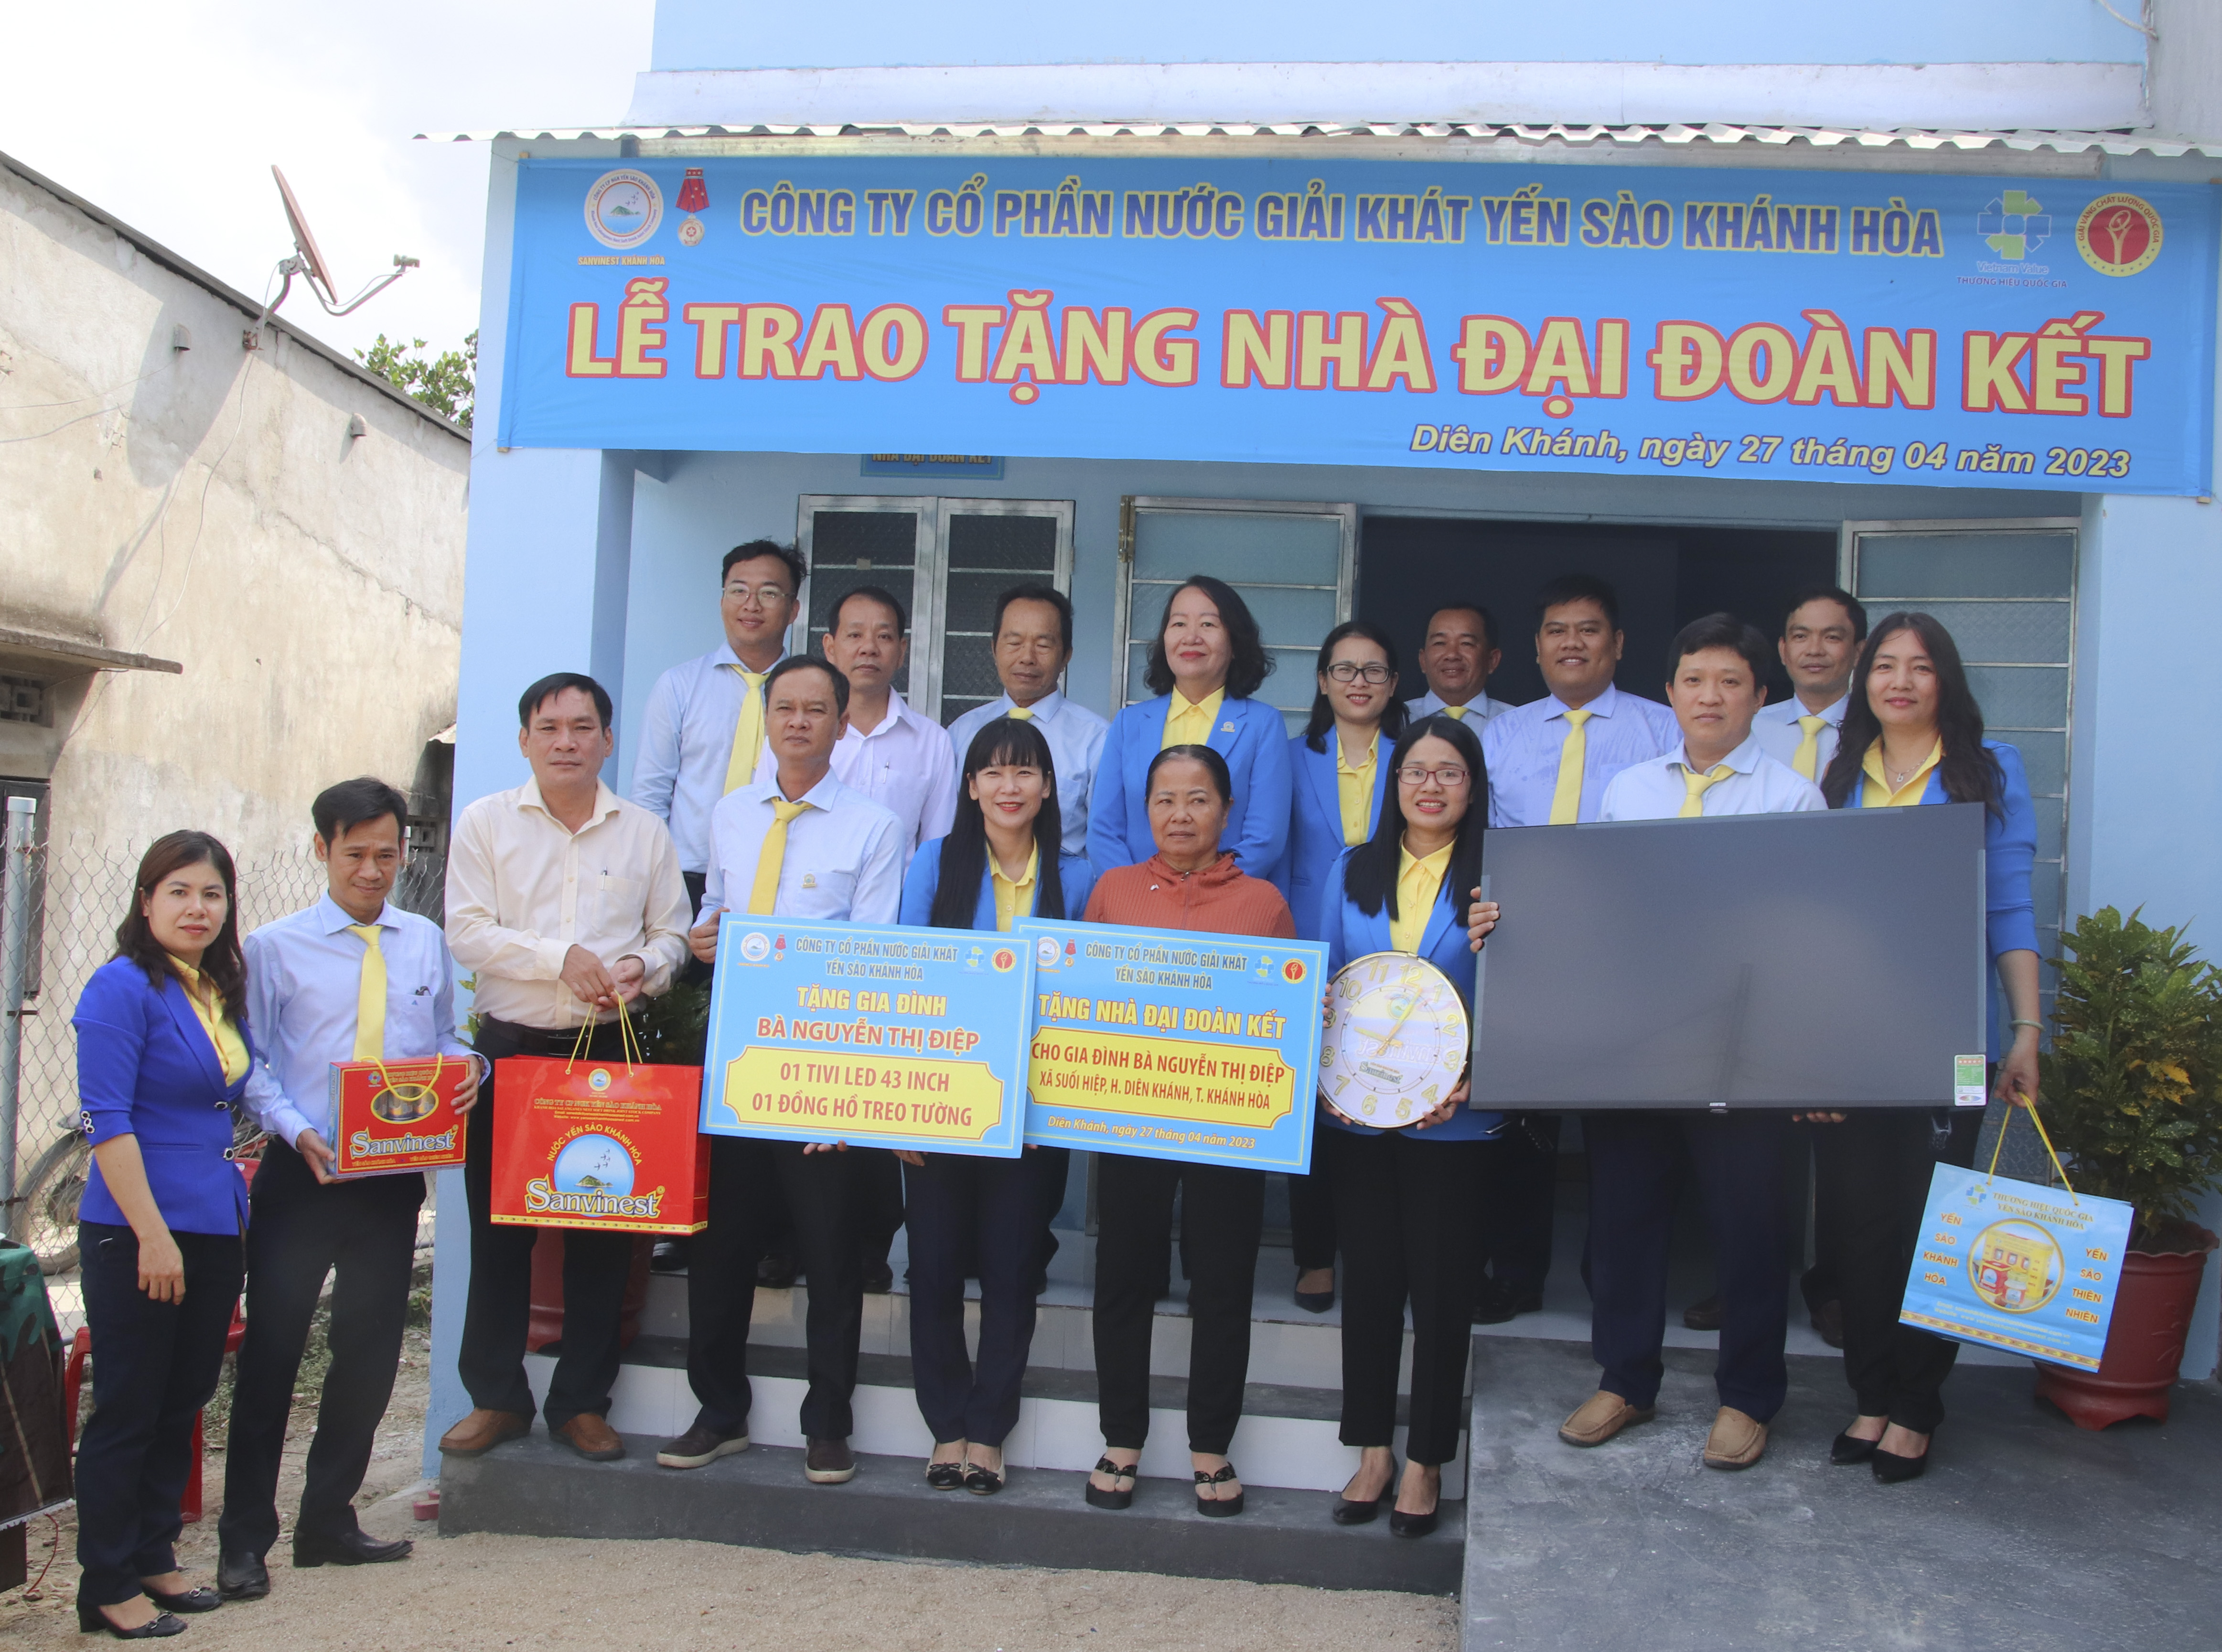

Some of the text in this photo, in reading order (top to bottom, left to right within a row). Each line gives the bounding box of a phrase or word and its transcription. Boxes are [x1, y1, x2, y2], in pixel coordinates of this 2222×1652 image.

[741, 181, 855, 236] CÔNG
[866, 189, 916, 236] TY
[925, 173, 988, 236] CỔ
[994, 176, 1114, 238] PHẦN
[1123, 182, 1244, 239] NƯỚC
[1256, 179, 1346, 240] GIẢI
[1356, 185, 1471, 243] KHÁT
[1482, 183, 1569, 247] YẾN
[1580, 190, 1673, 249] SÀO
[1684, 194, 1839, 253] KHÁNH
[1851, 197, 1943, 257] HÒA
[2081, 206, 2096, 225] VÀNG
[2096, 195, 2116, 208] CHẤT
[2117, 196, 2145, 210] LƯỢNG
[2144, 208, 2159, 228] QUỐC
[578, 255, 665, 265] SANVINEST KHÁNH HÒA
[1977, 261, 2049, 274] Vietnam Value
[1957, 276, 2067, 288] THƯƠNG HIỆU QUỐC GIA
[566, 277, 2150, 418] LỄ TRAO TẶNG NHÀ ĐẠI ĐOÀN KẾT
[1410, 424, 2130, 477] Diên Khánh, ngày 27 tháng 04 năm 2023
[796, 936, 958, 961] CÔNG TY CỔ PHẦN NƯỚC GIẢI KHÁT
[1086, 941, 1247, 971] CÔNG TY CỔ PHẦN NƯỚC GIẢI KHÁT
[827, 957, 923, 980] YẾN SÀO KHÁNH HÒA
[1116, 964, 1212, 989] YẾN SÀO KHÁNH HÒA
[1368, 960, 1390, 984] 11
[1399, 962, 1423, 988] 12
[797, 983, 947, 1017] TẶNG GIA ĐÌNH
[1339, 977, 1362, 1001] 10
[1433, 983, 1444, 1003] 1
[1038, 991, 1286, 1039] TẶNG NHÀ ĐẠI ĐOÀN KẾT
[1324, 1008, 1337, 1029] 9
[1442, 1014, 1461, 1037] 2
[757, 1015, 979, 1055] BÀ NGUYỄN THỊ ĐIỆP
[1031, 1042, 1285, 1088] CHO GIA ĐÌNH BÀ NGUYỄN THỊ ĐIỆP
[1320, 1046, 1335, 1067] 8
[1444, 1051, 1461, 1073] 3
[780, 1062, 949, 1092] 01 TIVI LED 43 INCH
[1040, 1068, 1270, 1110] XÃ SUỐI HIỆP, H. DIÊN KHÁNH, T. KHÁNH HÒA
[1336, 1074, 1351, 1096] 7
[1362, 1094, 1377, 1116] 6
[1421, 1083, 1439, 1104] 4
[752, 1090, 971, 1126] 01 ĐỒNG HỒ TREO TƯỜNG
[1395, 1097, 1413, 1120] 5
[350, 1129, 456, 1159] Sanvinest
[547, 1122, 643, 1166] NƯỚC YẾN SÀO KHÁNH HÒA
[1048, 1116, 1256, 1148] Diên Khánh, ngày 27 tháng 04 năm 2023
[525, 1177, 661, 1218] Sanvinest
[1993, 1192, 2093, 1222] THƯƠNG HIỆU QUỐC GIA
[1941, 1212, 1962, 1226] YẾN
[1997, 1203, 2084, 1230] YẾN SÀO KHÁNH HÒA
[1934, 1232, 1955, 1244] SÀO
[1923, 1251, 1958, 1267] KHÁNH
[2086, 1247, 2108, 1261] YẾN
[1924, 1272, 1947, 1286] HÒA
[2080, 1268, 2102, 1281] SÀO
[2072, 1288, 2102, 1303] THIÊN
[2066, 1308, 2099, 1323] NHIÊN
